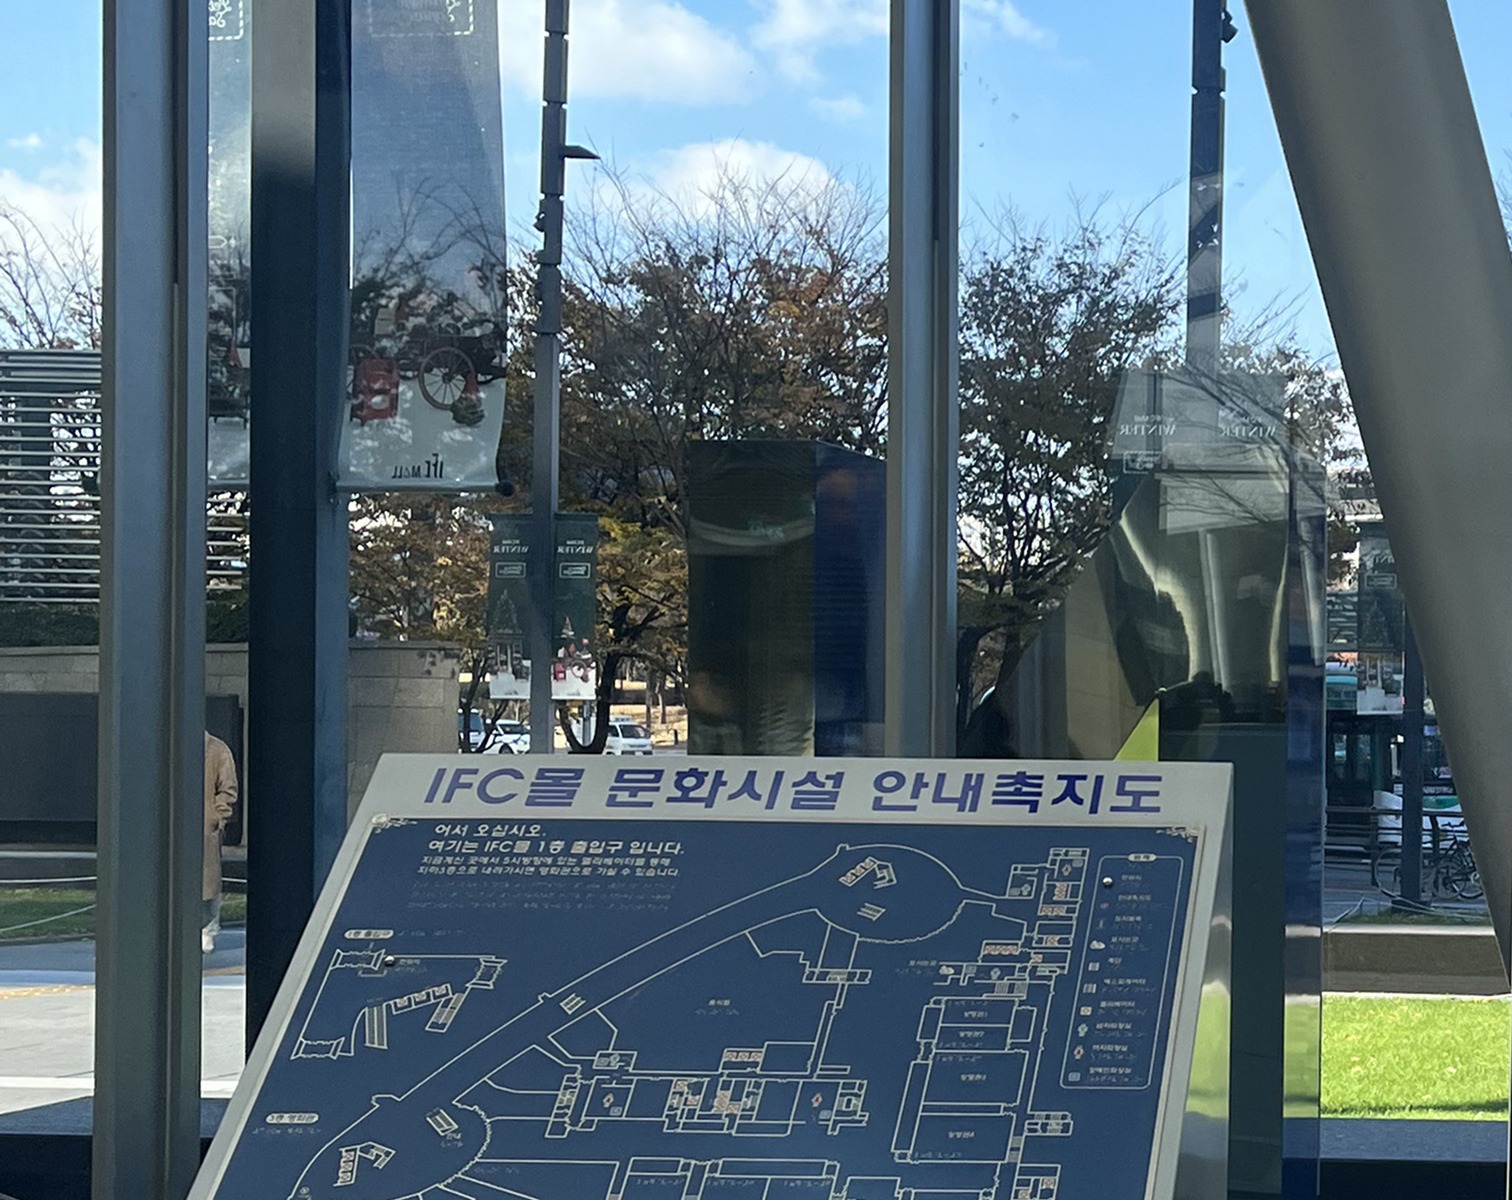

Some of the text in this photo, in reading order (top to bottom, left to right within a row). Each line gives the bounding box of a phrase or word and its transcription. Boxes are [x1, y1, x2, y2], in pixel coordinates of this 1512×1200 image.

[424, 767, 1163, 815] IFC몰 문화시설 안내촉지도
[435, 824, 547, 838] 어서 오십시오.
[428, 840, 479, 853] 여기는
[484, 841, 530, 854] IFC몰
[570, 841, 623, 855] 출입구
[629, 842, 685, 856] 입니다.
